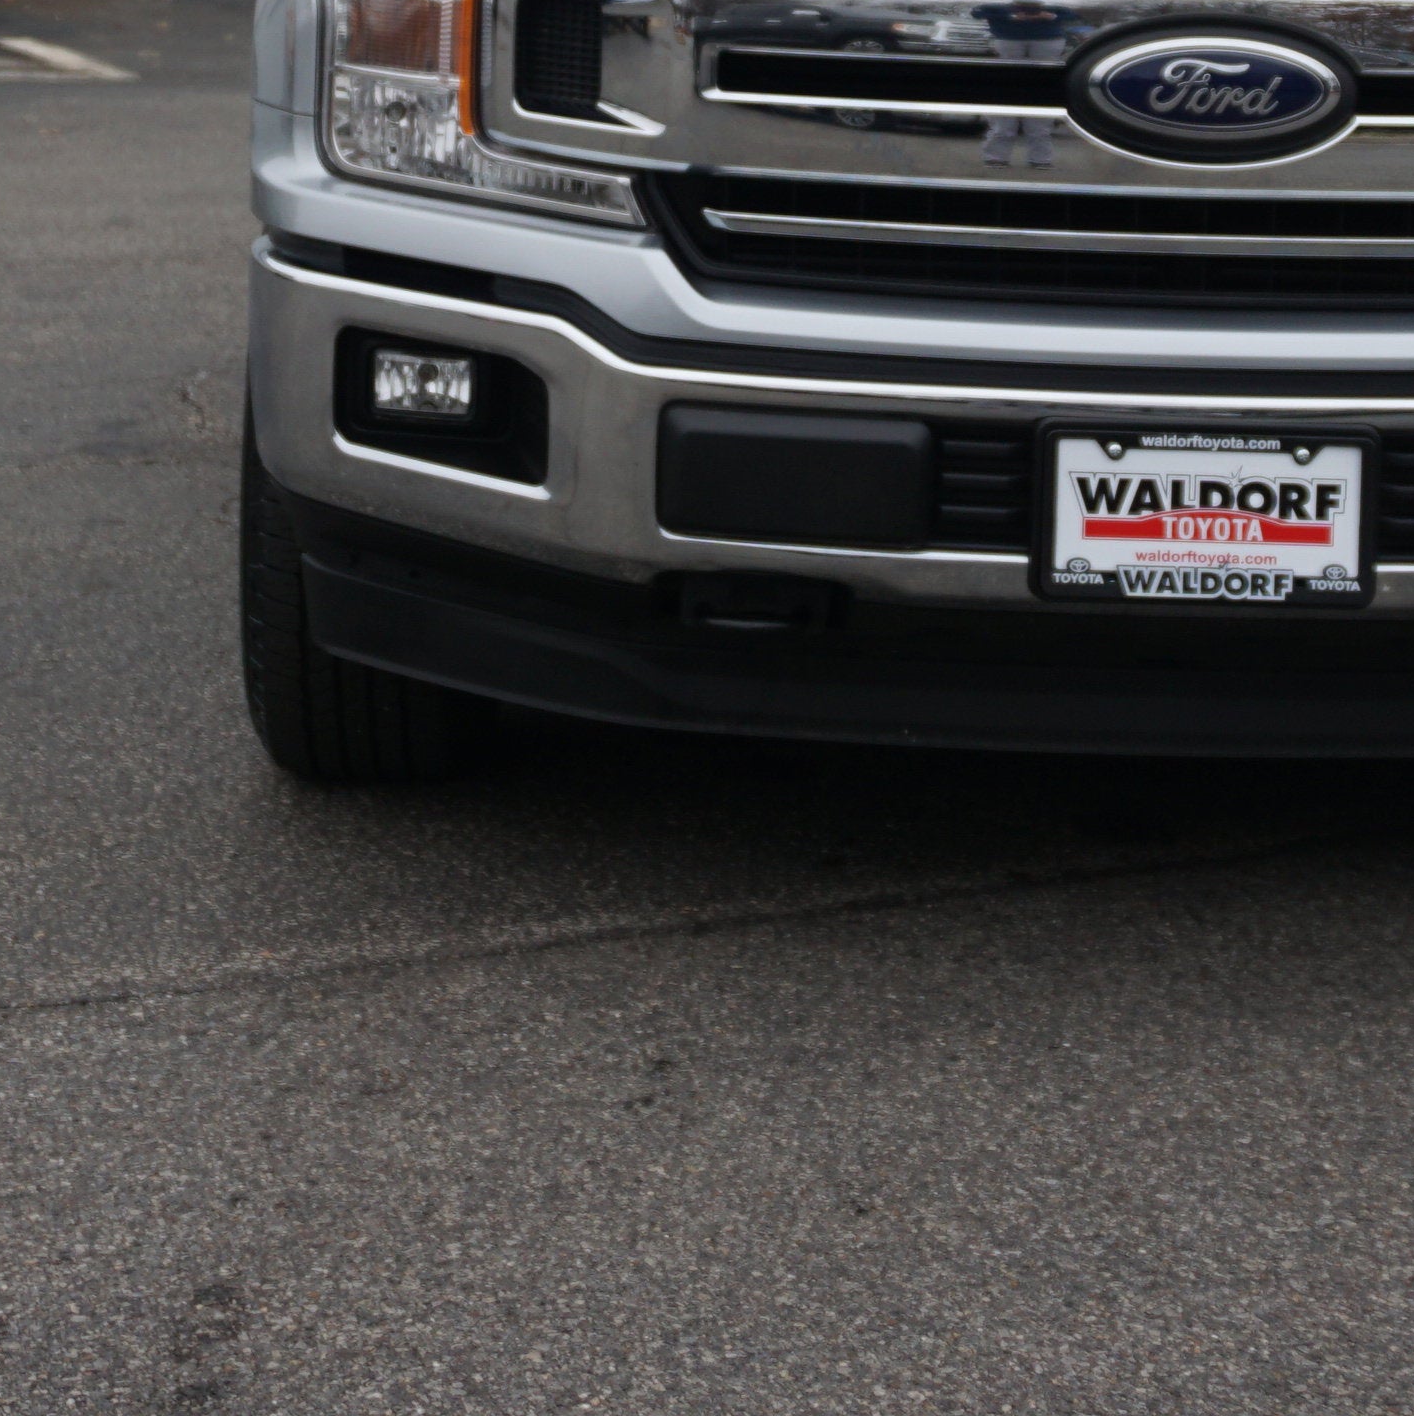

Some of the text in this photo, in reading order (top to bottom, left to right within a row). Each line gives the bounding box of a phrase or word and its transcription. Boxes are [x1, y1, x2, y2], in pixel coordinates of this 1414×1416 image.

[1149, 58, 1283, 116] Ford
[1142, 434, 1281, 451] waldorftoyota.com
[1075, 476, 1342, 521] WALDORF
[1162, 515, 1264, 542] TOYOTA
[1135, 549, 1277, 567] waldorftoyota.com
[1053, 568, 1361, 599] TOYOTA WALDORF TOYOTA
